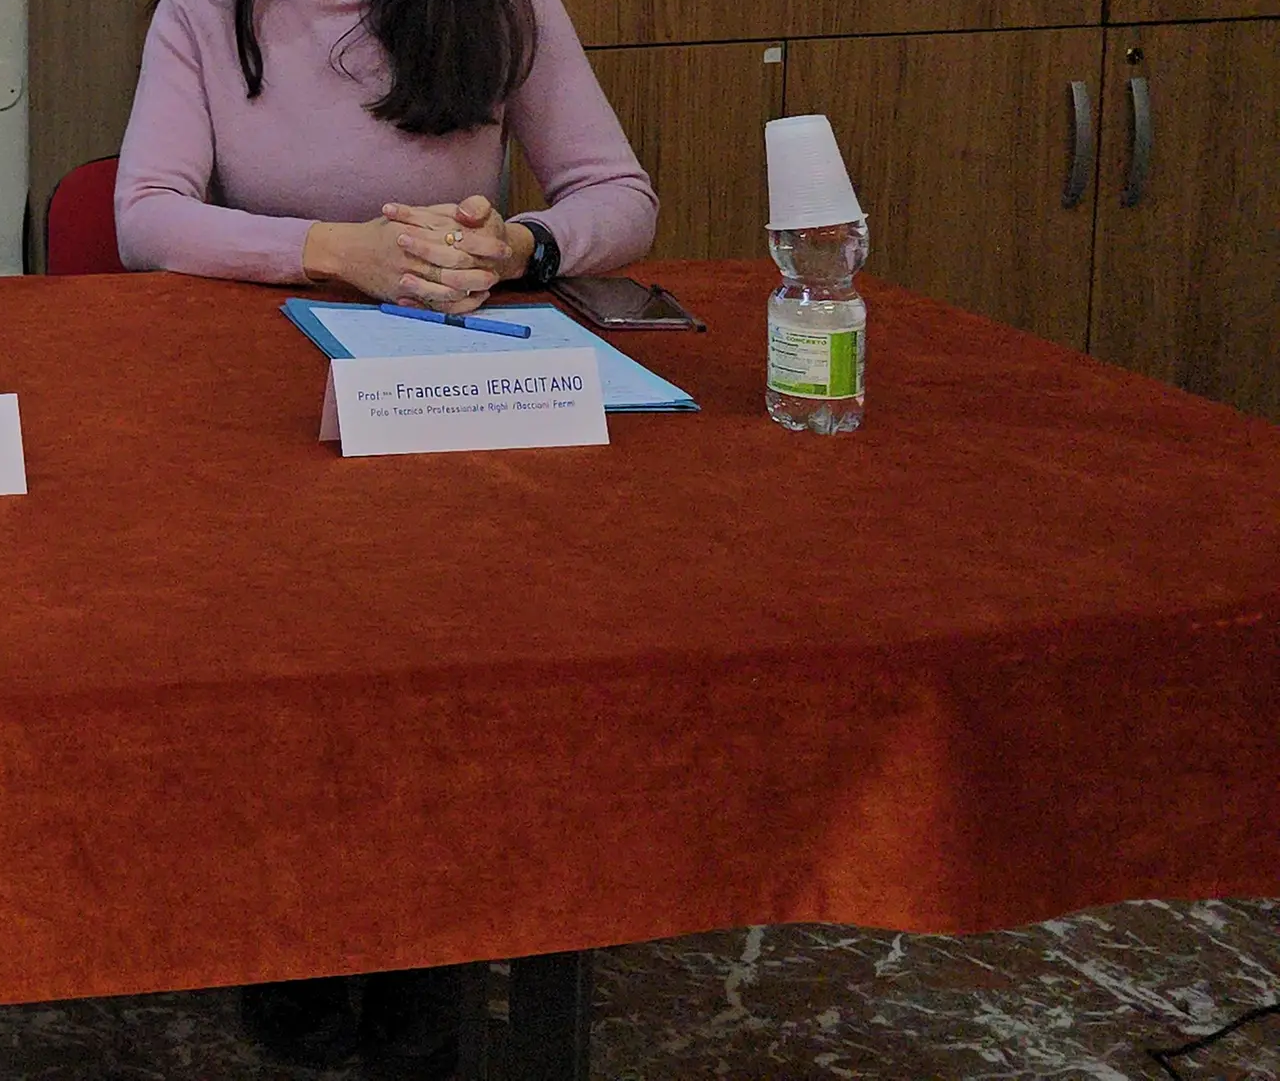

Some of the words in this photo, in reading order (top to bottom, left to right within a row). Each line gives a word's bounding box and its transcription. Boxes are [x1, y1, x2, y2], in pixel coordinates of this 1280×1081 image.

[396, 382, 480, 400] Francesca
[486, 375, 584, 395] IERACITANO
[370, 408, 390, 418] Polo
[393, 406, 424, 416] Tecnico
[426, 403, 484, 415] Professionale
[488, 401, 509, 414] Righi
[553, 399, 576, 409] Fermi
